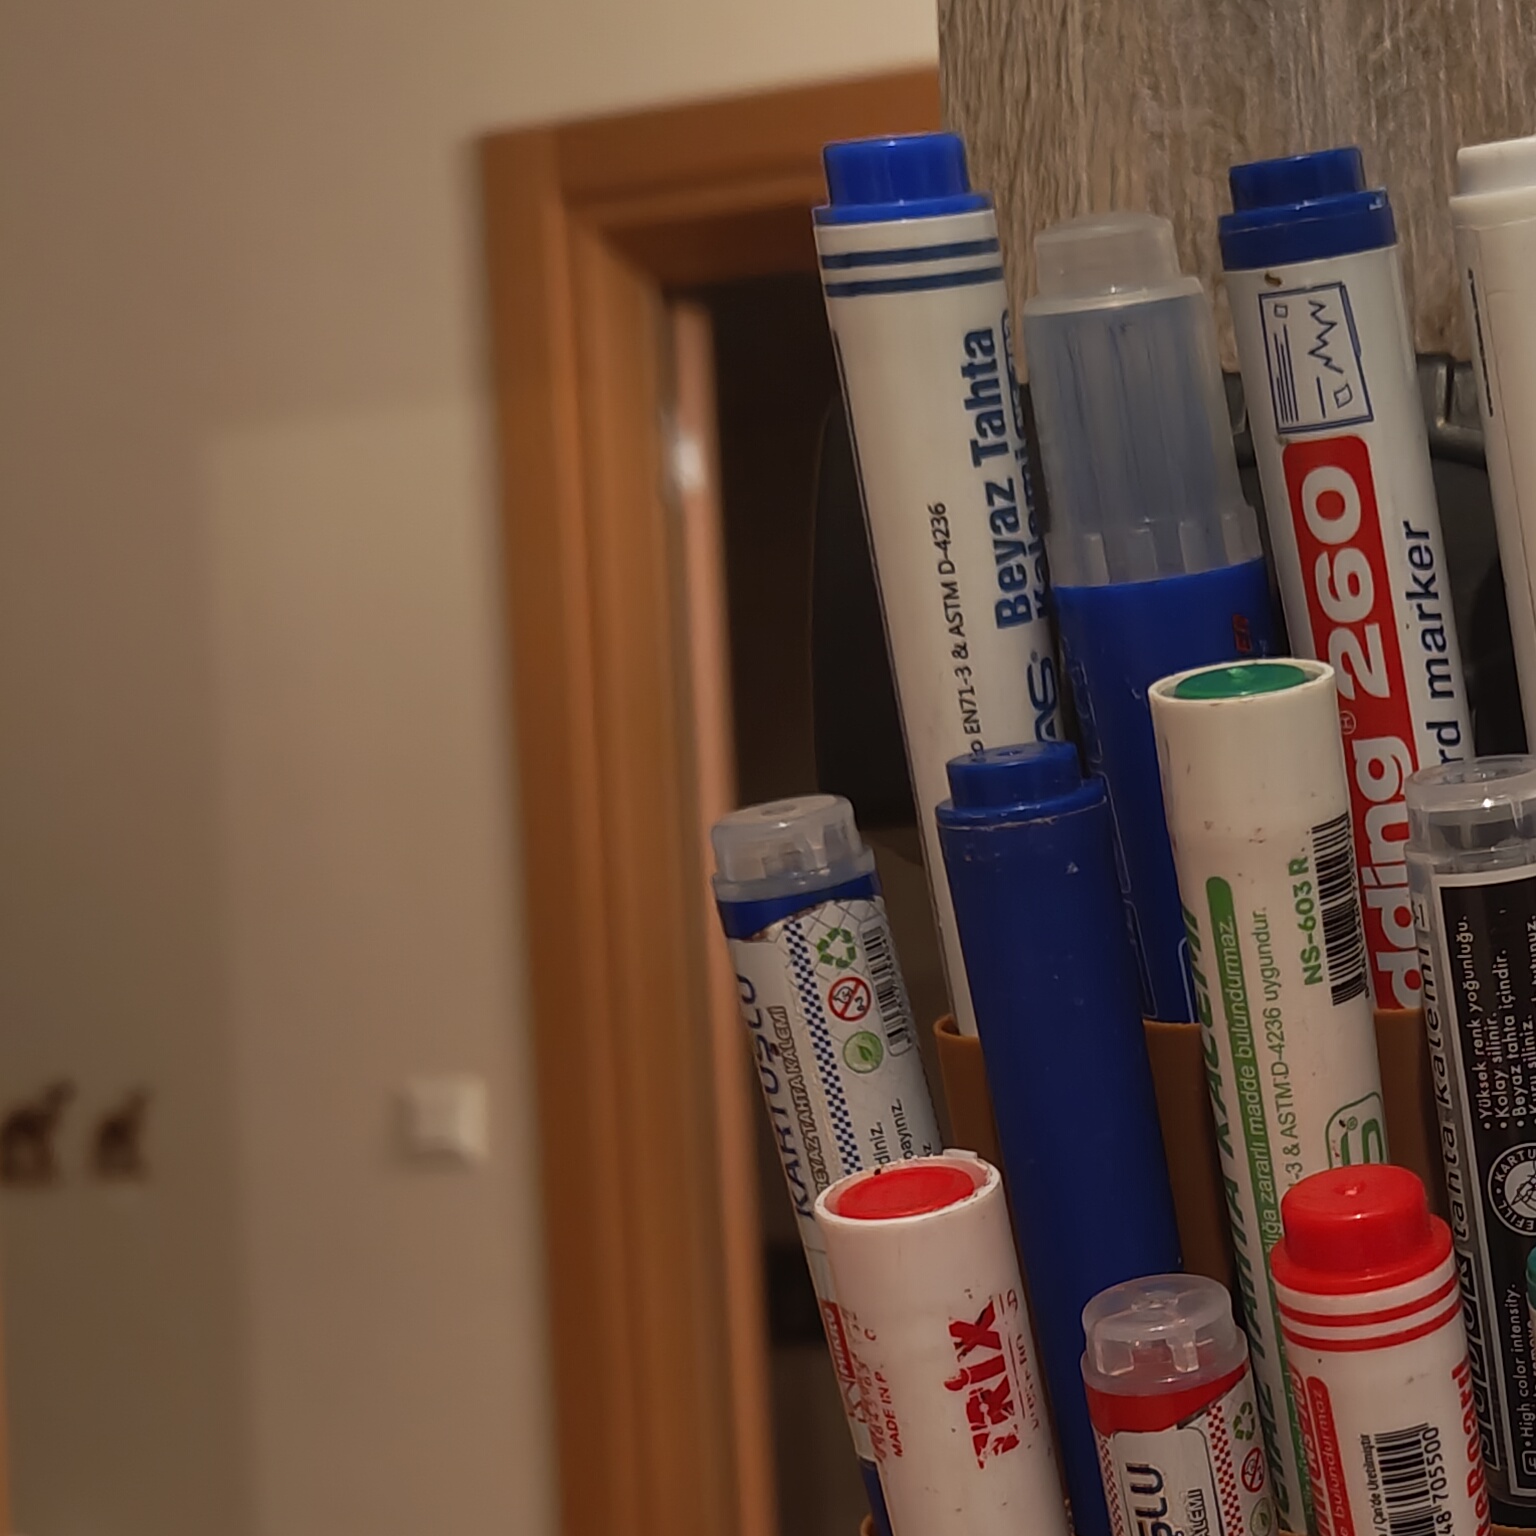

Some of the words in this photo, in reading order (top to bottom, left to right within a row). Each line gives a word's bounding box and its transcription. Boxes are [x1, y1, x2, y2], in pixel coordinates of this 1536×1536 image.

[962, 327, 1010, 467] Tahta
[927, 499, 957, 575] D-4236
[983, 477, 1034, 628] Beyaz
[939, 580, 965, 639] ASTM
[1299, 465, 1392, 706] 260
[1403, 521, 1457, 698] marker
[950, 642, 968, 660] &
[953, 665, 980, 734] EN71-3
[1355, 734, 1422, 1008] dding
[1249, 907, 1282, 1002] uygundur.
[1290, 877, 1322, 989] NS-603
[1452, 914, 1483, 1014] yoğunluğu.
[1212, 914, 1253, 1061] bulundurmaz.
[1492, 948, 1518, 1011] içindir.
[1259, 1005, 1290, 1078] D-4236
[1465, 1016, 1486, 1057] renk
[1485, 1011, 1503, 1064] silinir.
[1500, 1013, 1519, 1059] tahta
[1235, 1063, 1265, 1134] madde
[1271, 1081, 1299, 1140] ASTM
[1470, 1059, 1494, 1119] Yüksek
[1490, 1067, 1511, 1119] Kolay
[1507, 1061, 1528, 1118] Beyaz
[1247, 1137, 1276, 1206] zararlı
[1281, 1141, 1301, 1158] &
[1507, 1282, 1524, 1353] intensity.
[1510, 1356, 1530, 1397] color
[883, 1406, 905, 1458] MADE
[1421, 1425, 1449, 1503] 705500
